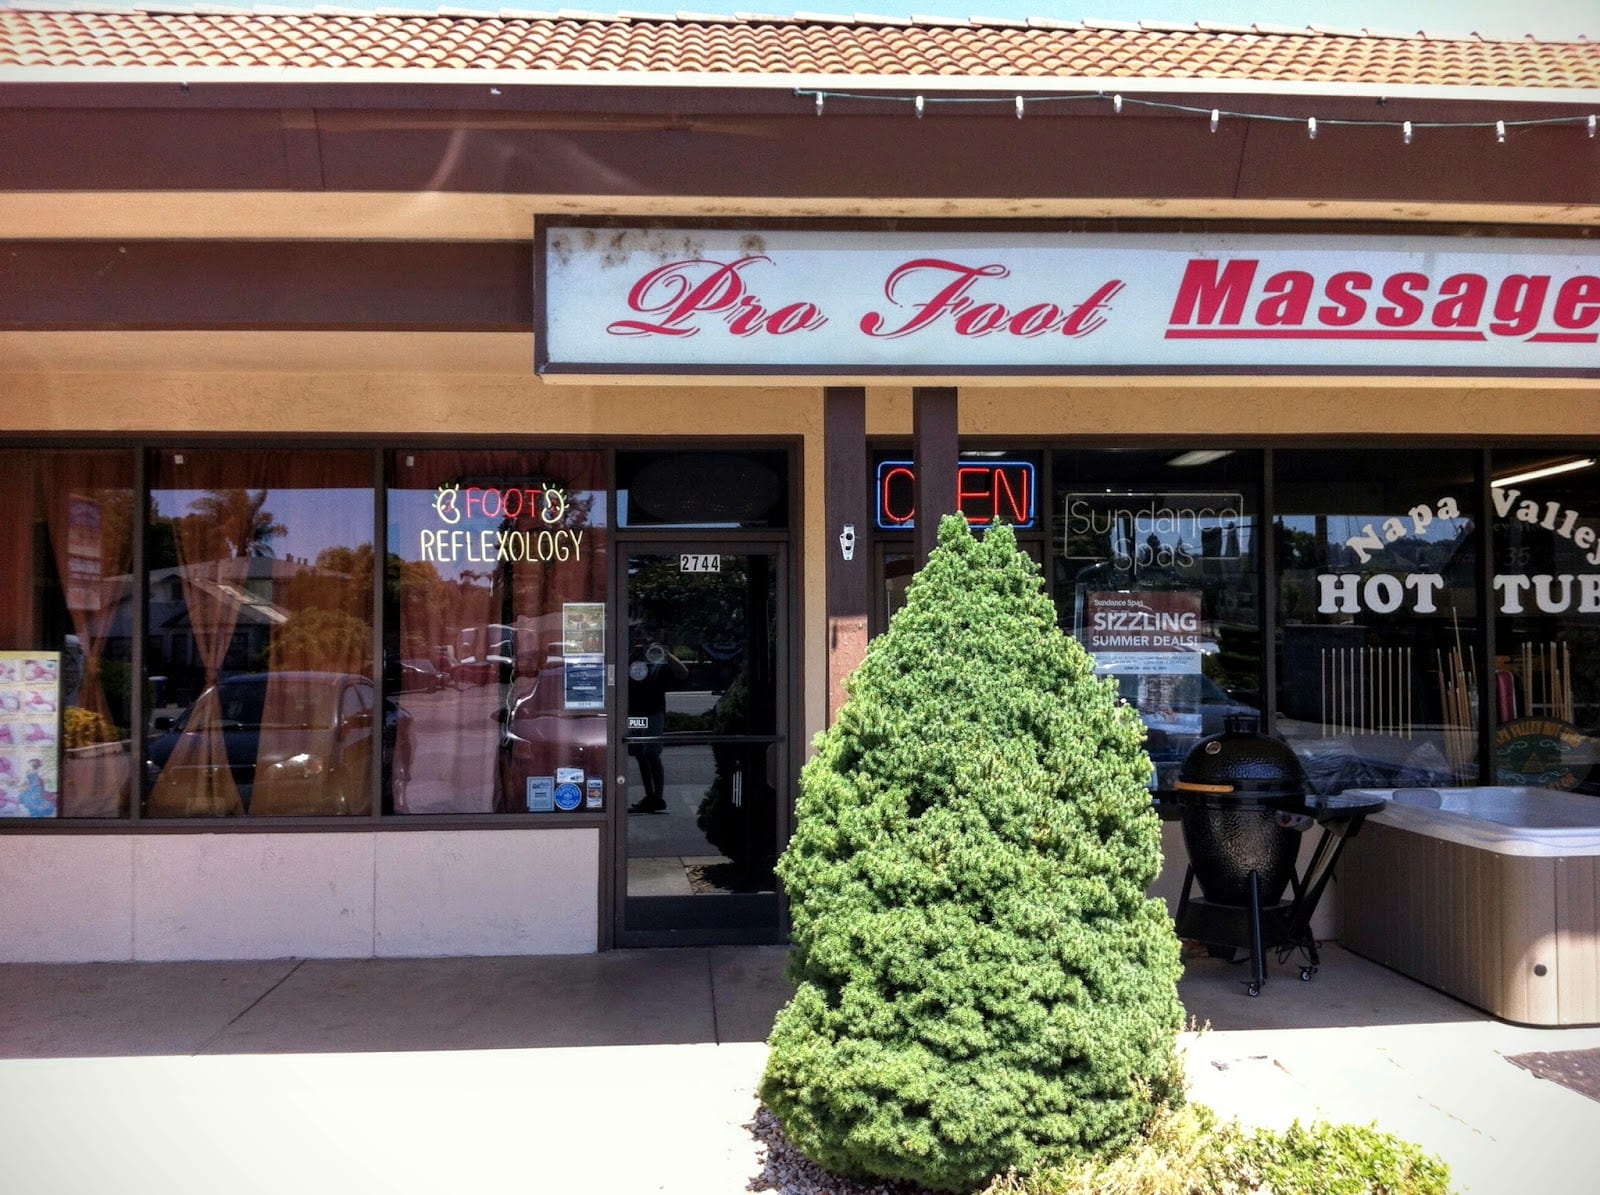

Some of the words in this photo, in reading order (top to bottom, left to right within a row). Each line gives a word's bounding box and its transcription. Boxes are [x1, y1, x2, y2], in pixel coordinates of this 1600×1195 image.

[606, 255, 829, 338] Pro
[860, 257, 1126, 339] Foot
[1166, 258, 1600, 337] Massage
[465, 486, 542, 519] FOOT
[884, 466, 1027, 523] OEN
[1070, 500, 1239, 539] Sundance
[1346, 496, 1461, 564] Napa
[420, 529, 584, 562] REFLEXOLOGY
[681, 555, 719, 572] 2744
[1093, 599, 1127, 607] Sundance
[1317, 573, 1444, 614] HOT
[1093, 611, 1198, 631] SIZZLING
[1092, 635, 1150, 647] SUMMER
[1153, 635, 1198, 647] DEALS!
[629, 719, 647, 727] PULL
